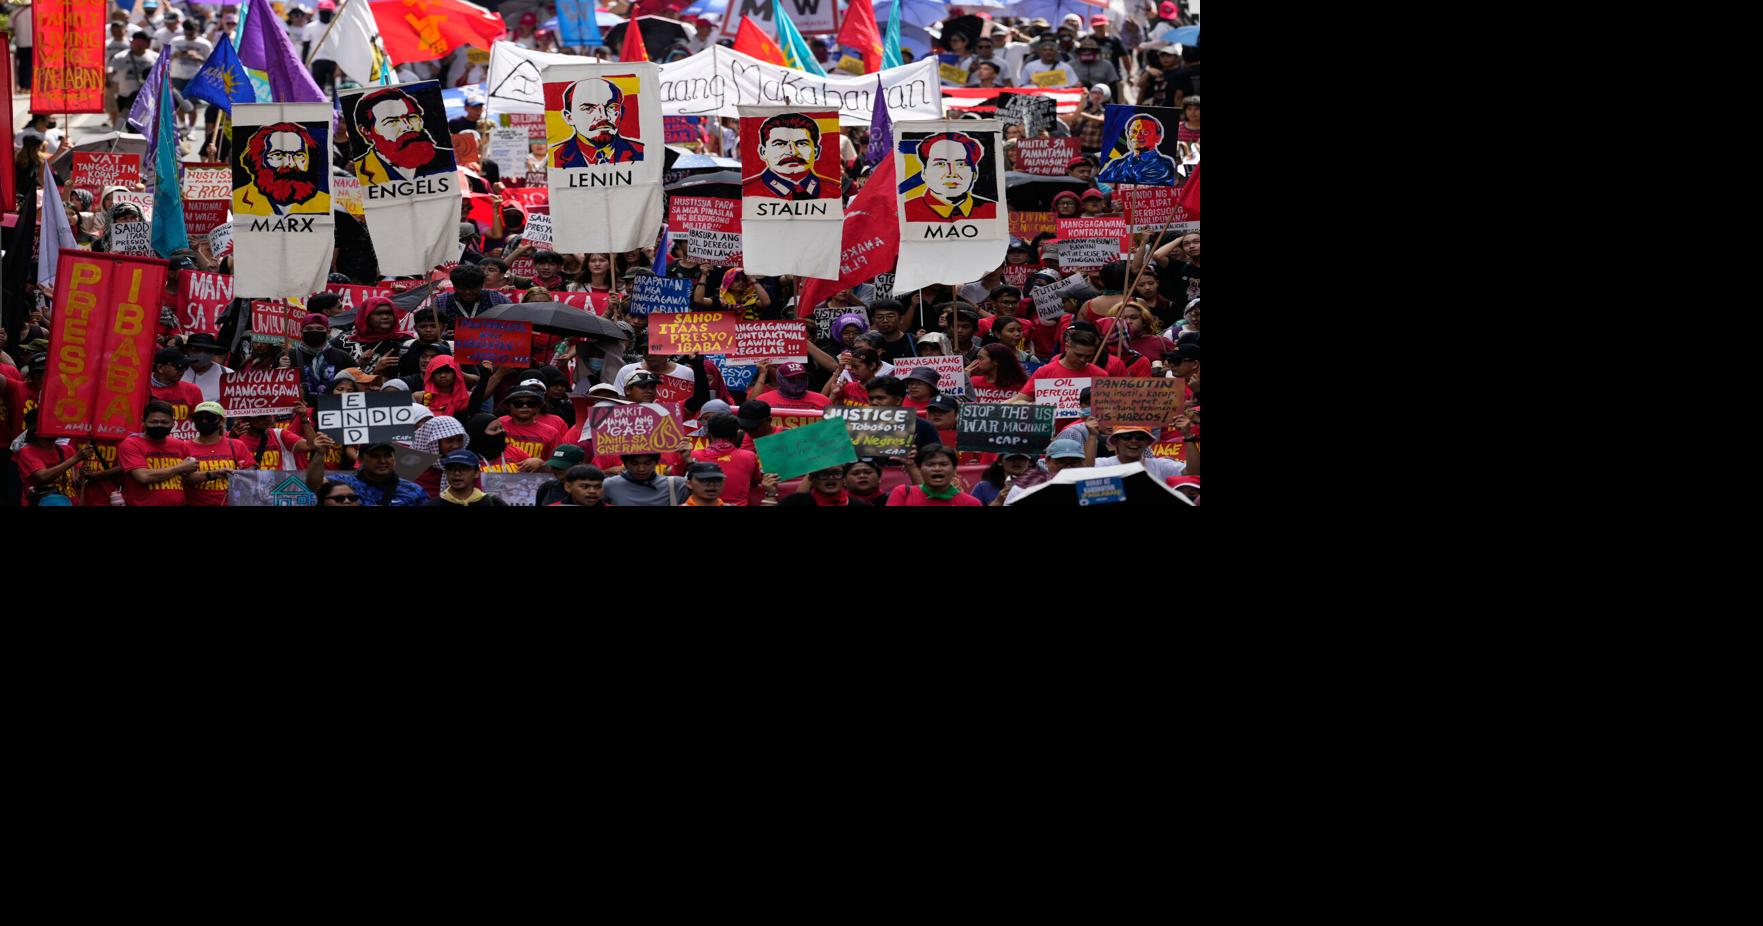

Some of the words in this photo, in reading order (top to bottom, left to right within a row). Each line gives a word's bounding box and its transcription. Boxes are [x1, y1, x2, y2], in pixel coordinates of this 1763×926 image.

[1017, 139, 1049, 149] MILITAR
[1053, 138, 1066, 149] SA
[89, 154, 122, 164] VAT
[1020, 148, 1074, 159] PAMANTASAN
[76, 162, 138, 174] TANGGALIN,
[88, 170, 120, 180] KORAP
[187, 171, 232, 180] HUSTISY
[569, 170, 632, 188] LENIN
[74, 176, 136, 187] PANAGUTIN
[368, 177, 449, 199] ENGELS
[1125, 190, 1153, 201] PNDO
[1155, 189, 1168, 199] NG
[188, 202, 223, 211] NATIONAL
[673, 198, 712, 208] HUSTISYA
[714, 199, 735, 210] PARA
[682, 206, 699, 214] MGA
[756, 202, 827, 216] STALIN
[1134, 206, 1184, 218] SERBISYOG
[250, 217, 315, 233] MARX
[529, 214, 552, 224] SAH
[676, 213, 687, 221] NG
[688, 213, 731, 225] BERDUGONG
[1060, 219, 1127, 230] MANGGAGAWANG
[114, 222, 150, 235] SAHOD
[525, 222, 553, 234] PRESY
[923, 224, 979, 239] MAO
[1067, 228, 1127, 239] KONTRAKTWAL,
[689, 229, 718, 241] IBASURA
[720, 233, 740, 242] ANG
[688, 238, 700, 247] OIL
[714, 248, 732, 257] LAW
[511, 259, 533, 268] FEN
[188, 271, 236, 300] MAN
[633, 275, 684, 292] KARAPATAN
[1033, 278, 1072, 297] TUTULAN
[644, 285, 662, 296] MGA
[631, 293, 688, 306] MANGGAGAWA
[183, 302, 206, 331] SA
[673, 313, 723, 324] SAHOD
[658, 323, 709, 335] ITAAS
[669, 331, 728, 345] PRESYO
[735, 331, 806, 340] ONTRAKTWAL
[676, 341, 722, 353] IBABA
[737, 339, 786, 347] GAWING
[735, 346, 786, 355] EGULAR
[895, 358, 940, 366] WAKASAN
[941, 356, 960, 365] ANG
[226, 369, 274, 384] UNYON
[275, 368, 295, 383] NG
[937, 380, 957, 388] RAN
[1053, 378, 1076, 387] OIL
[1094, 378, 1174, 389] PANAGUTIN
[223, 383, 300, 398] MANGGAGAWA
[613, 405, 644, 417] BAKIT
[823, 407, 909, 422] JUSTICE
[962, 404, 995, 417] STOP
[1000, 405, 1029, 419] THE
[1034, 406, 1052, 419] US
[634, 415, 654, 426] ANG
[962, 419, 1000, 433] WAR
[1002, 421, 1051, 433] MACHINE
[850, 422, 892, 432] Toboso
[597, 431, 626, 446] DAHIL
[631, 434, 647, 444] SA
